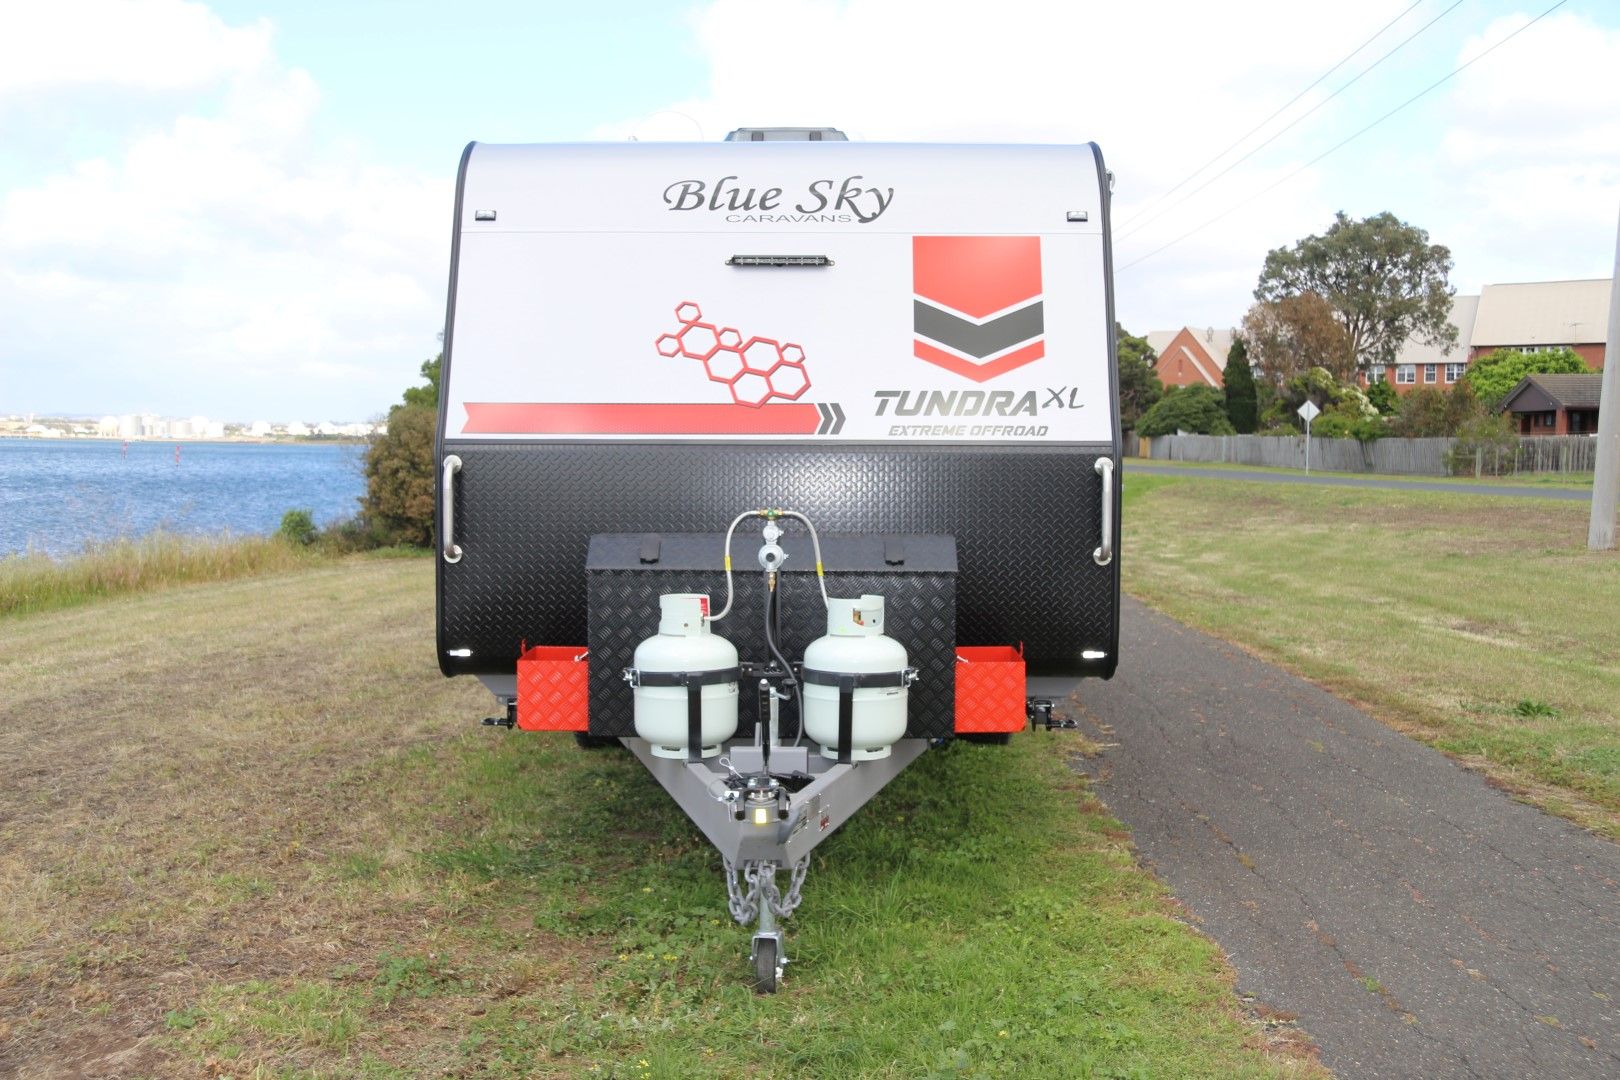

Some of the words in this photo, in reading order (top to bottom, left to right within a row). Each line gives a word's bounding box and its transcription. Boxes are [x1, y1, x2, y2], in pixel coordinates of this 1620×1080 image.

[663, 176, 782, 211] Blue
[795, 175, 894, 224] Sky
[726, 214, 852, 223] CARAVANS
[874, 390, 1038, 417] TUNDRA
[1041, 386, 1084, 409] XL
[888, 425, 967, 436] EXTREME
[970, 425, 1049, 436] OFFROAD
